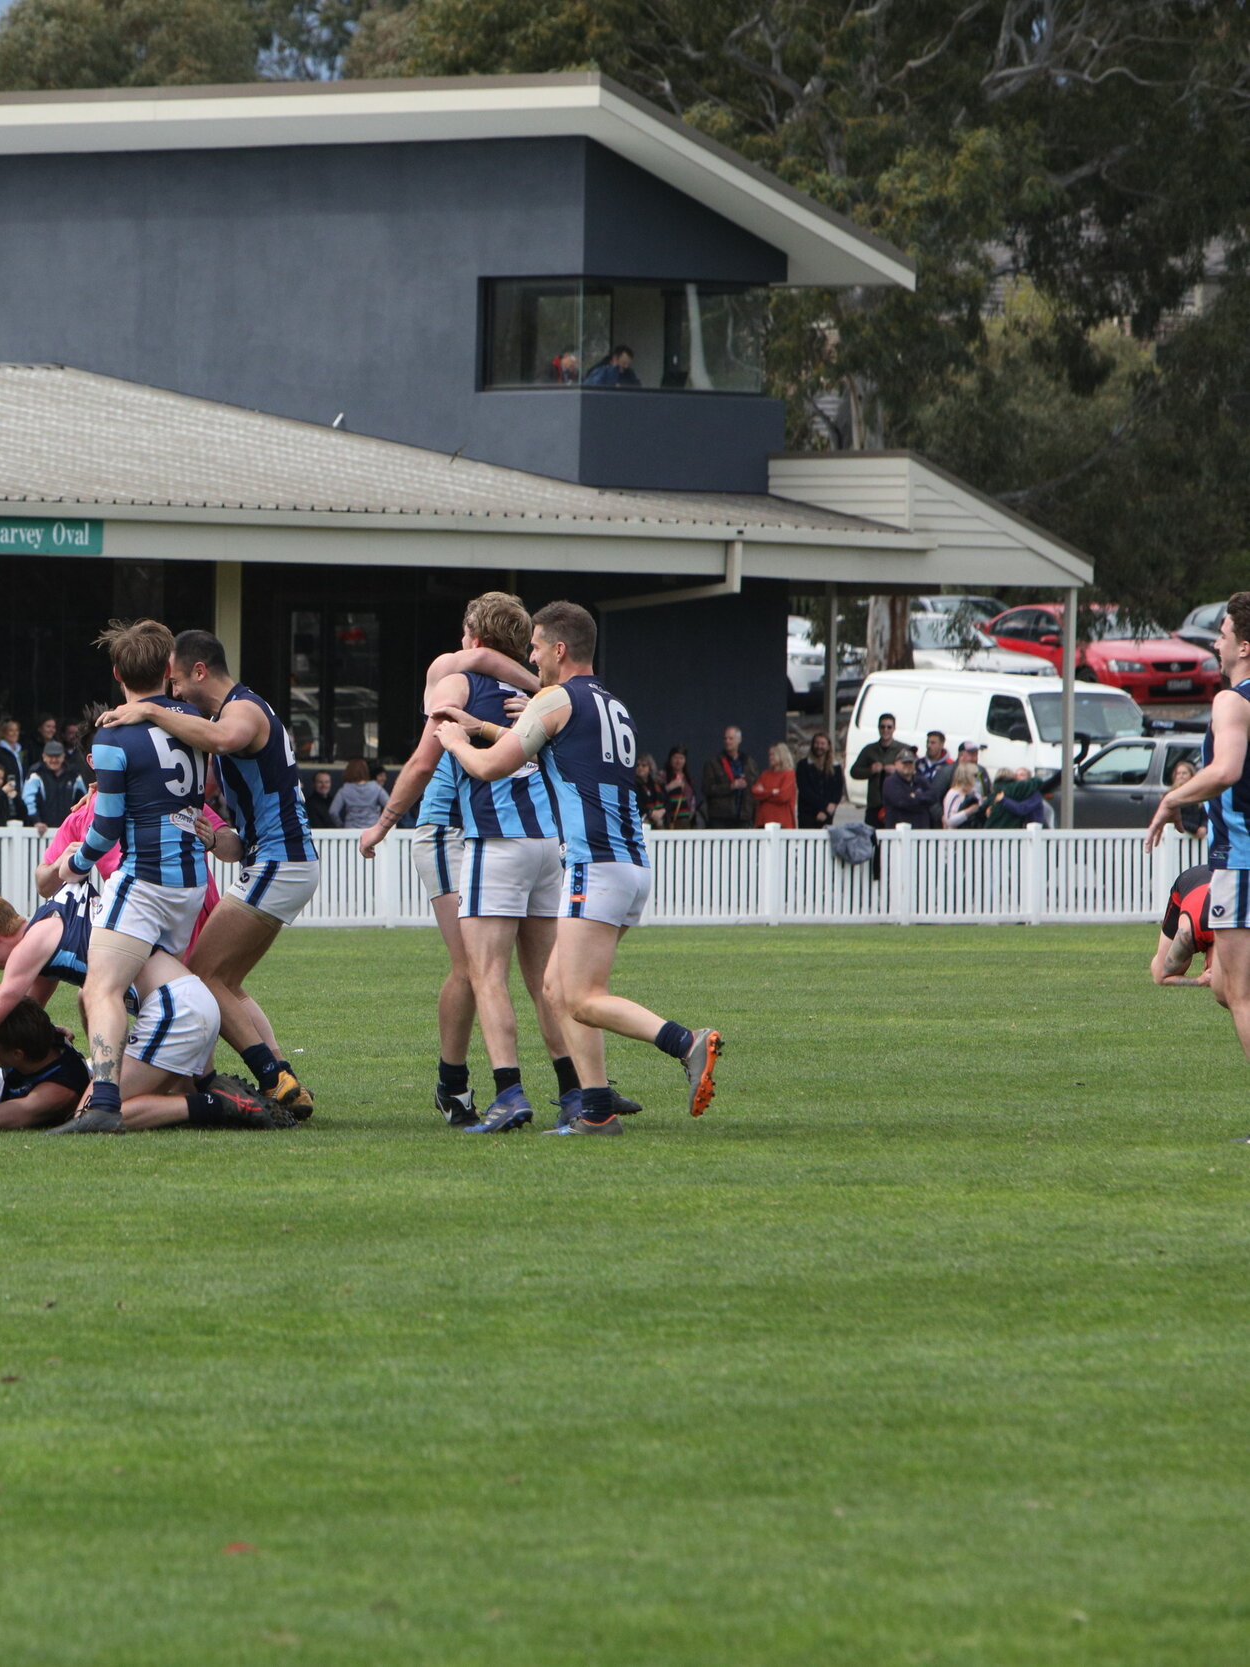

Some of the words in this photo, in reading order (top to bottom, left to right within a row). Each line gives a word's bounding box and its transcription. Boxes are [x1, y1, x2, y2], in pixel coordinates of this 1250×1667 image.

[52, 521, 90, 546] Oval
[147, 726, 205, 797] 51
[592, 692, 636, 768] 16
